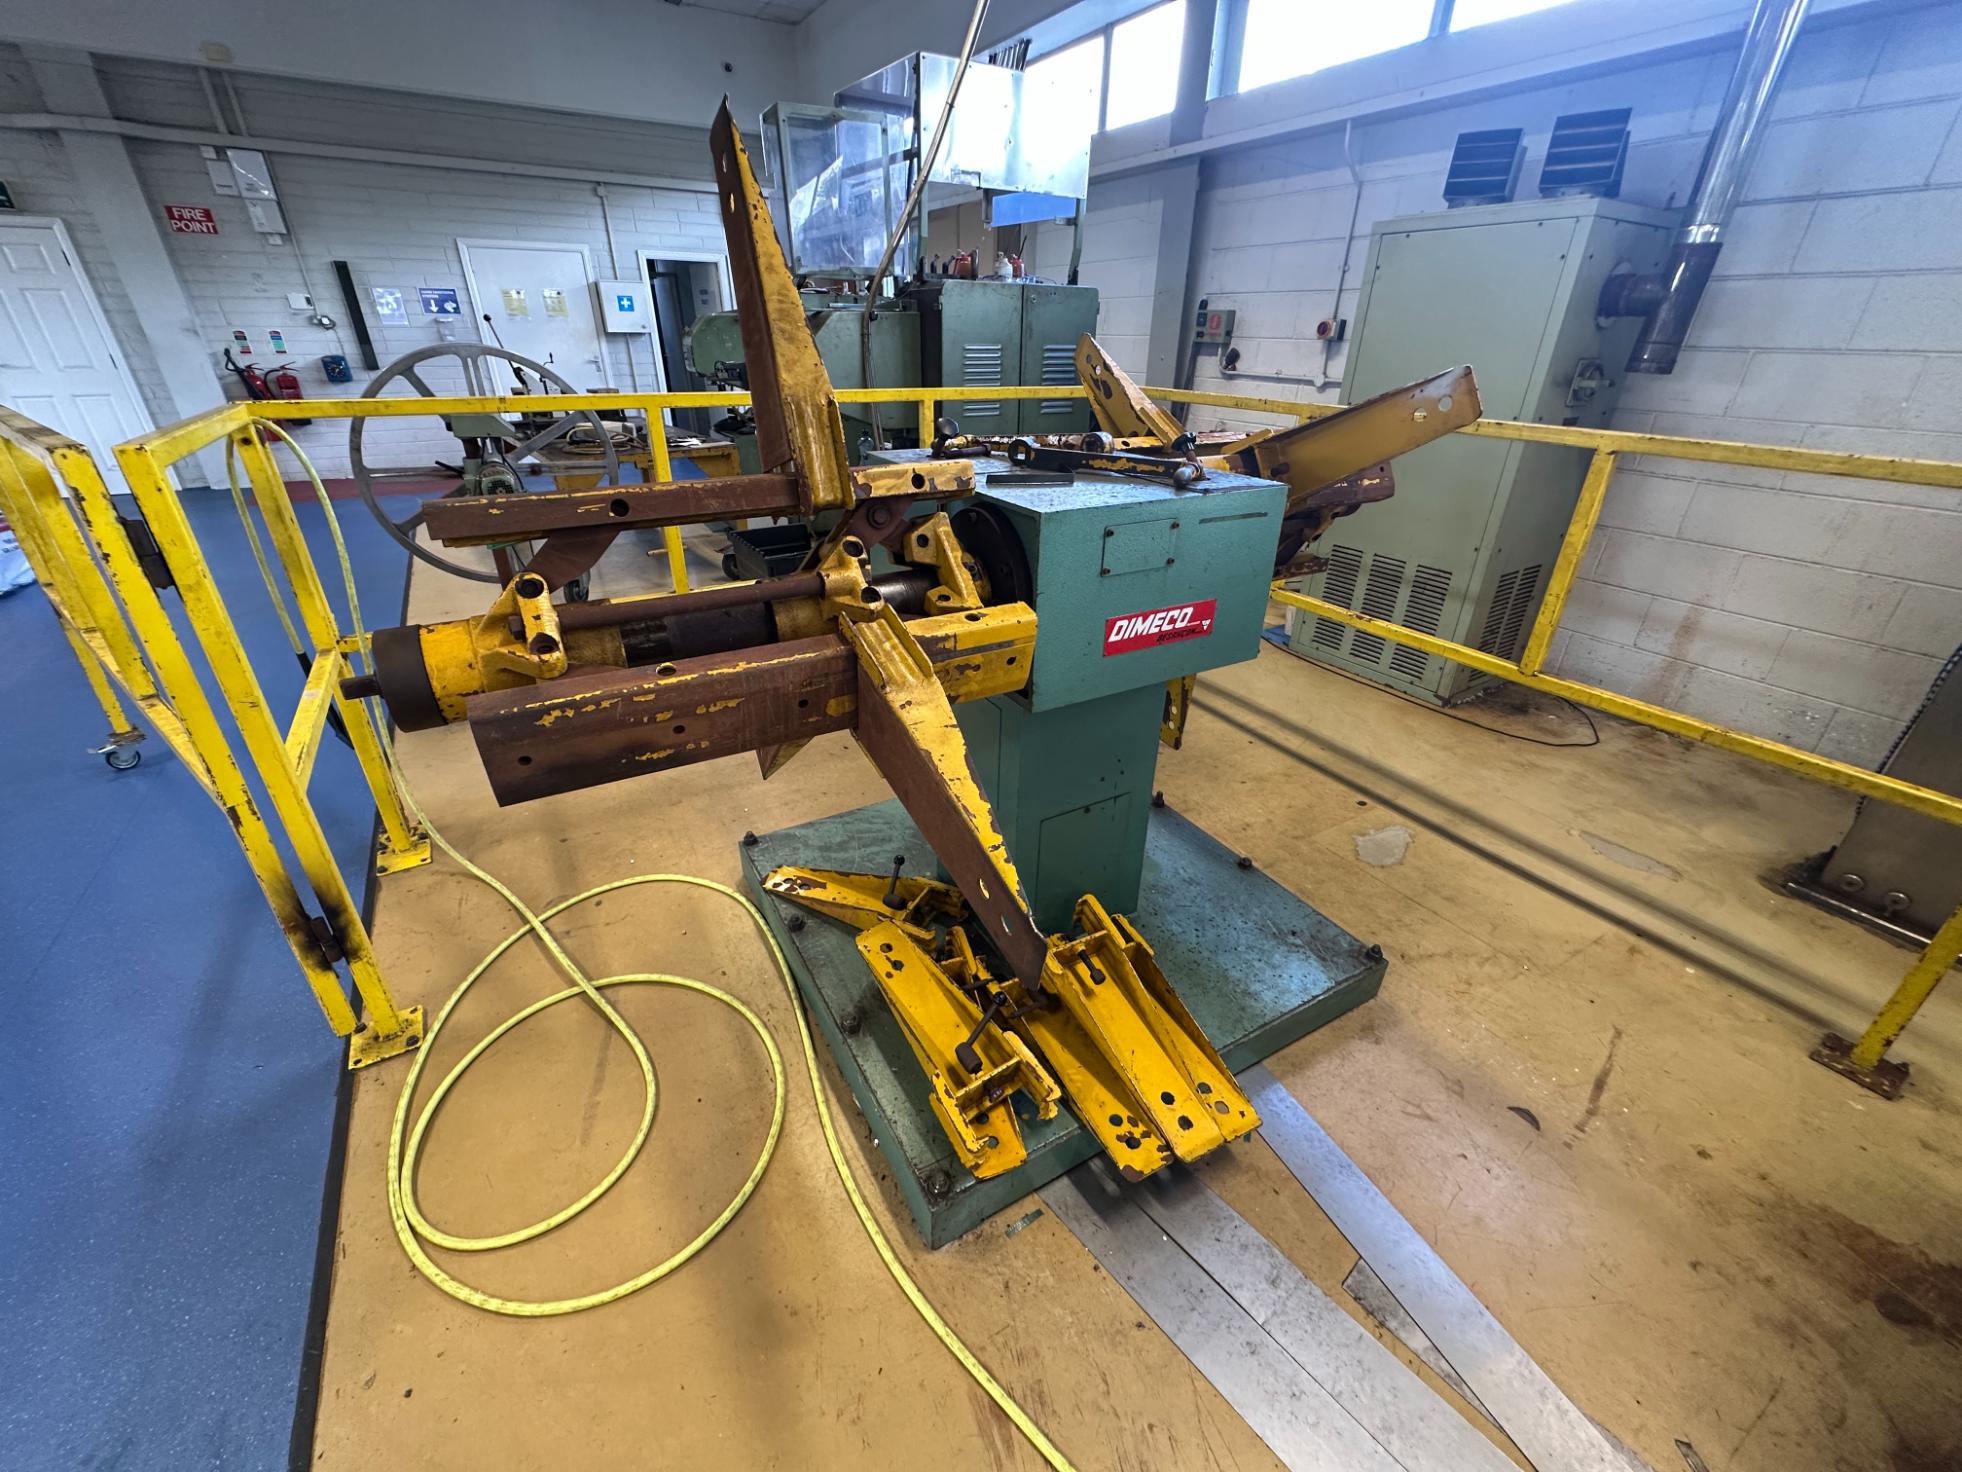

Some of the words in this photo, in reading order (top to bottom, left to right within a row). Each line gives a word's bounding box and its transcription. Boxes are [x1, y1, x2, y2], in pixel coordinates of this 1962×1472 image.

[171, 207, 207, 221] FIRE
[170, 219, 215, 233] POINT
[1108, 606, 1194, 643] DIMECO
